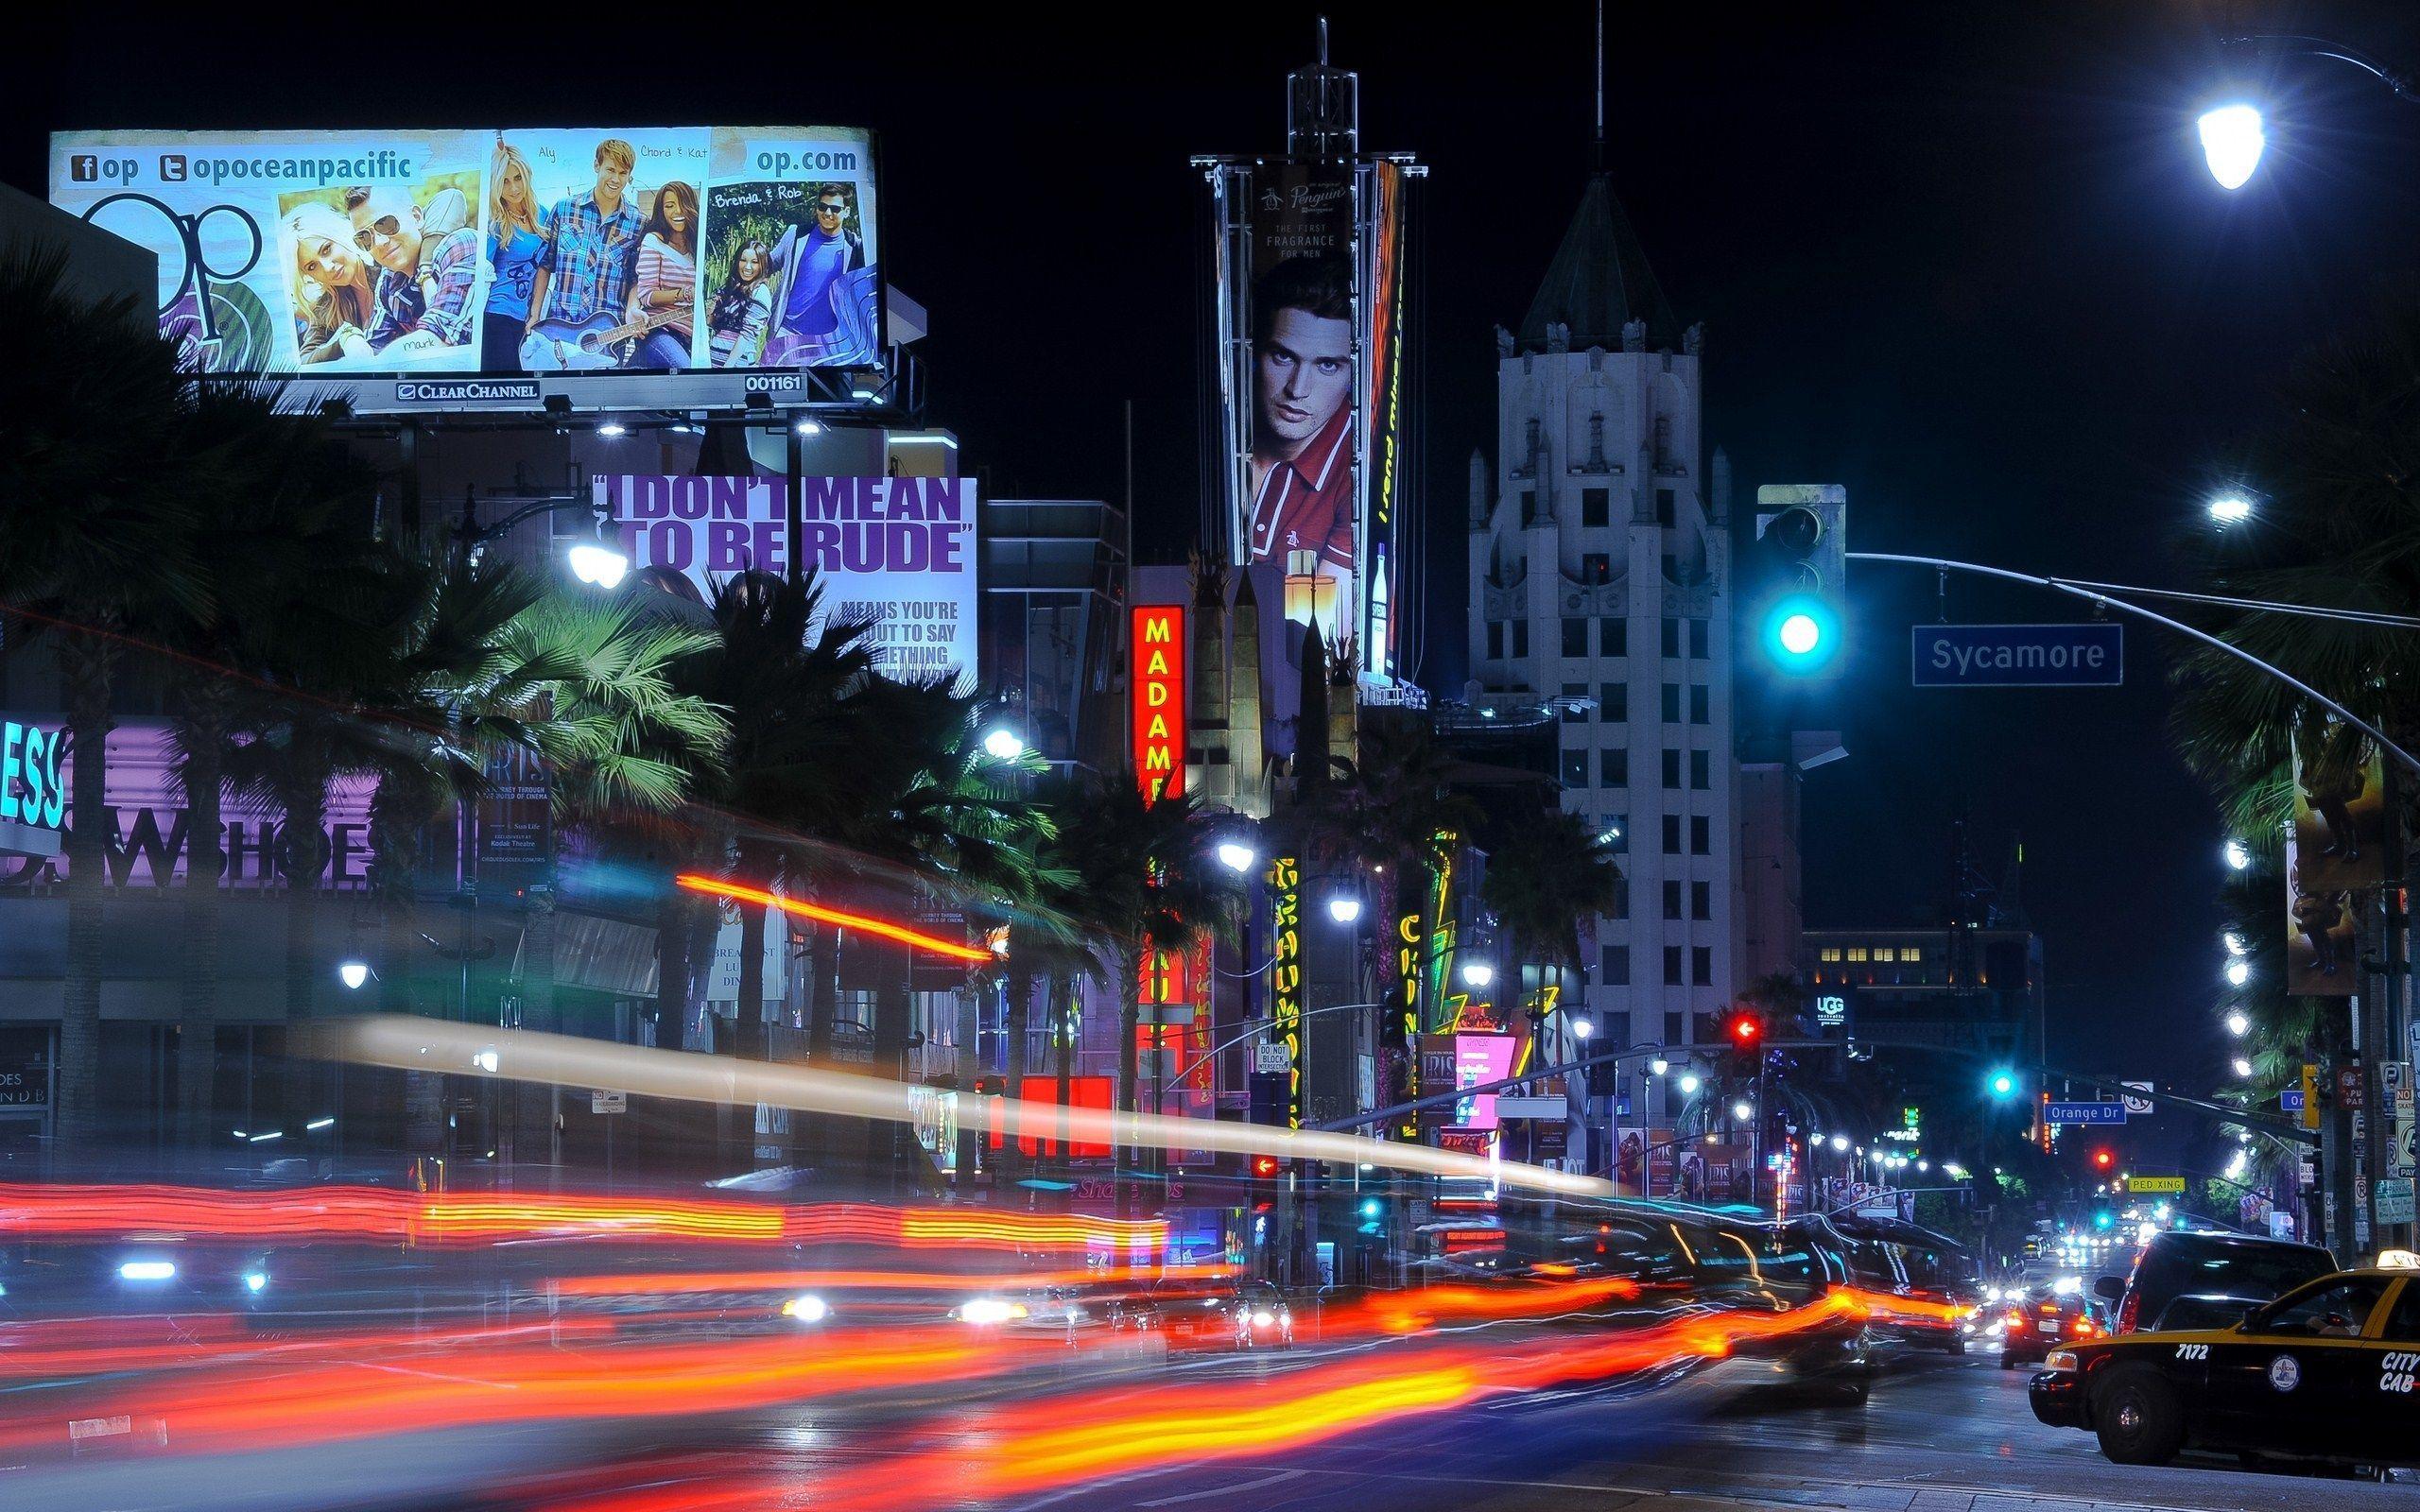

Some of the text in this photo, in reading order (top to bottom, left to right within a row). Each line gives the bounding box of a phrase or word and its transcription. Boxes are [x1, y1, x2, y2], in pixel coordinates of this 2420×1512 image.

[640, 145, 672, 159] Chord
[687, 146, 708, 159] Kat
[757, 149, 856, 173] op.com
[103, 157, 139, 185] op
[194, 151, 410, 185] opoceanpacific
[715, 192, 762, 208] Brenda
[778, 186, 802, 198] Rob
[1290, 185, 1346, 209] Penguin
[1298, 224, 1325, 232] FIRST
[1267, 236, 1335, 247] FRAGRANCE
[1281, 249, 1321, 258] FOR MEN
[746, 377, 801, 391] 001161
[632, 474, 788, 520] DON'T
[804, 476, 962, 521] MEAN
[621, 520, 694, 572] TO
[708, 521, 786, 572] BE
[901, 601, 959, 620] YOU'RE
[901, 624, 923, 642] TO
[926, 624, 957, 642] SAY
[1932, 639, 2105, 677] Sycamore
[716, 948, 775, 957] BREAST
[1817, 996, 1844, 1015] UGG
[1261, 1046, 1286, 1055] DO NOT
[1424, 1056, 1455, 1076] IRIS
[2397, 1090, 2411, 1100] NO
[2051, 1107, 2118, 1122] Orange Dr
[2157, 1180, 2181, 1189] XING
[2175, 1344, 2210, 1360] 7172
[2381, 1352, 2420, 1371] CITY
[2379, 1372, 2415, 1393] CAB
